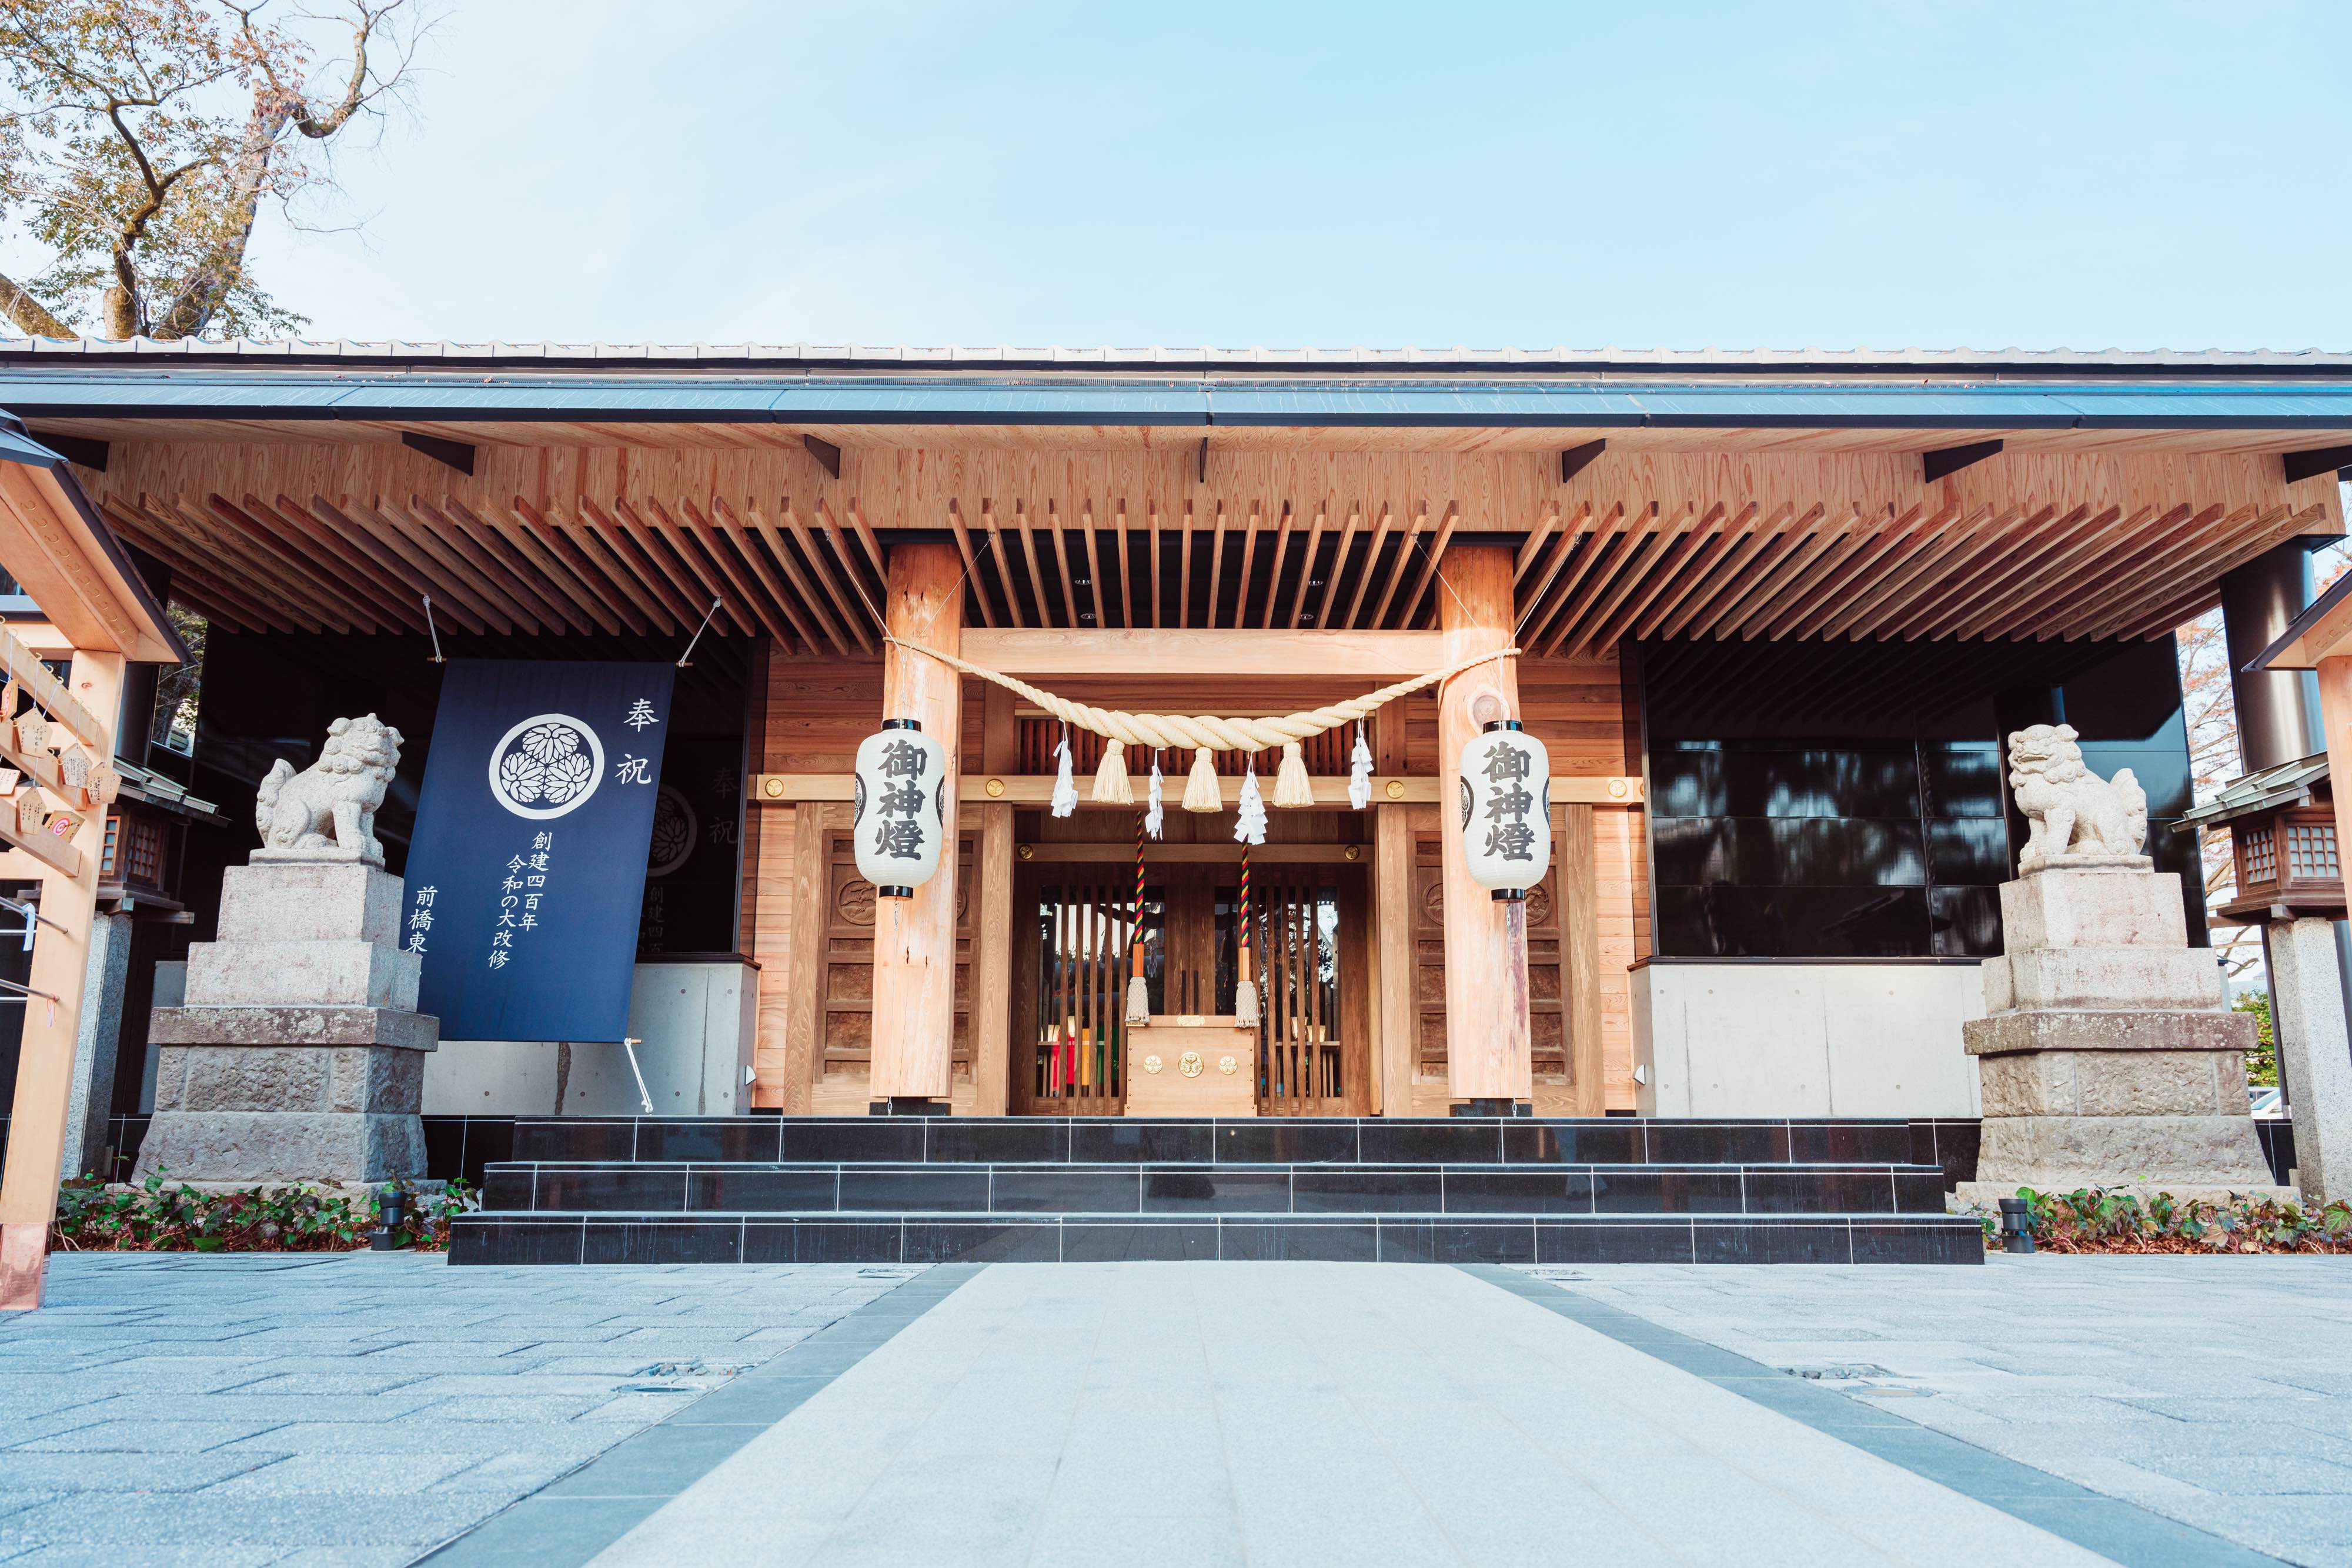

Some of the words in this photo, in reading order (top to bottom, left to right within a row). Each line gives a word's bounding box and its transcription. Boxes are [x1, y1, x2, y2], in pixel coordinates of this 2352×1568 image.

[614, 698, 660, 785] 奉祝
[874, 739, 927, 861] 御神燈
[1482, 741, 1535, 862] 御神燈
[405, 885, 438, 975] 前橋東
[488, 854, 528, 969] 令和の大改修
[518, 831, 553, 932] 創建四百年
